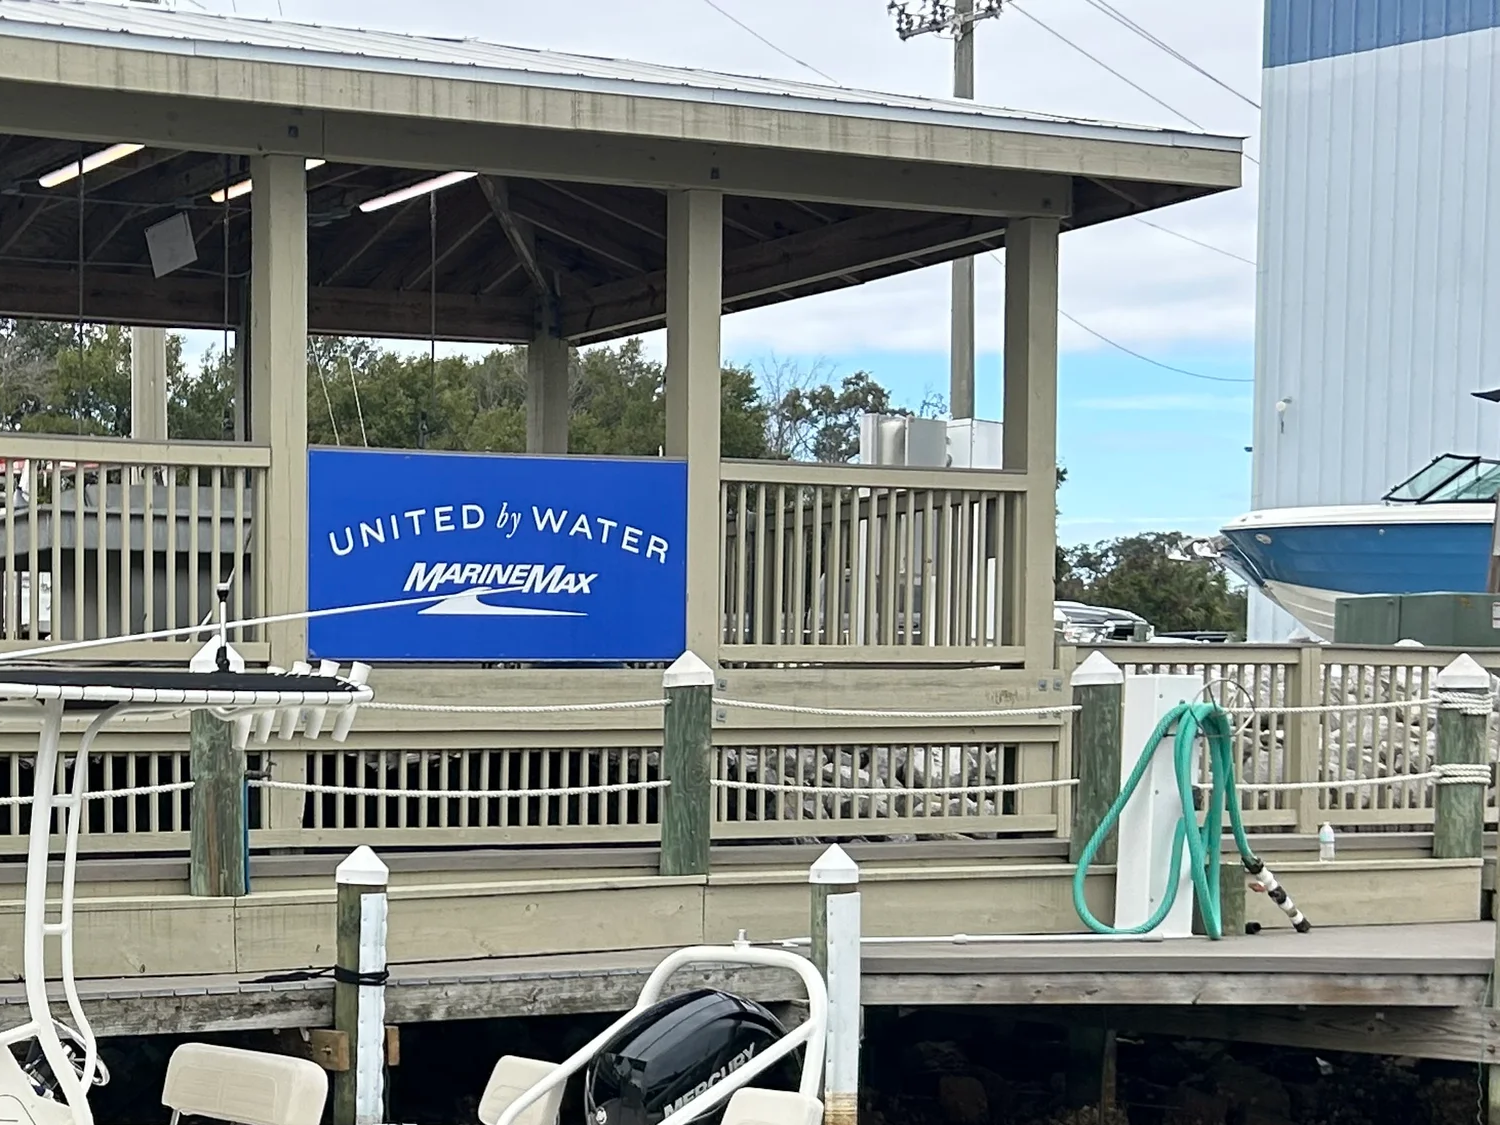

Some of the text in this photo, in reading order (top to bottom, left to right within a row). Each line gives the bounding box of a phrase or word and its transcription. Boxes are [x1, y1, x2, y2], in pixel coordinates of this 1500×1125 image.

[328, 501, 670, 564] UNITED by WATER
